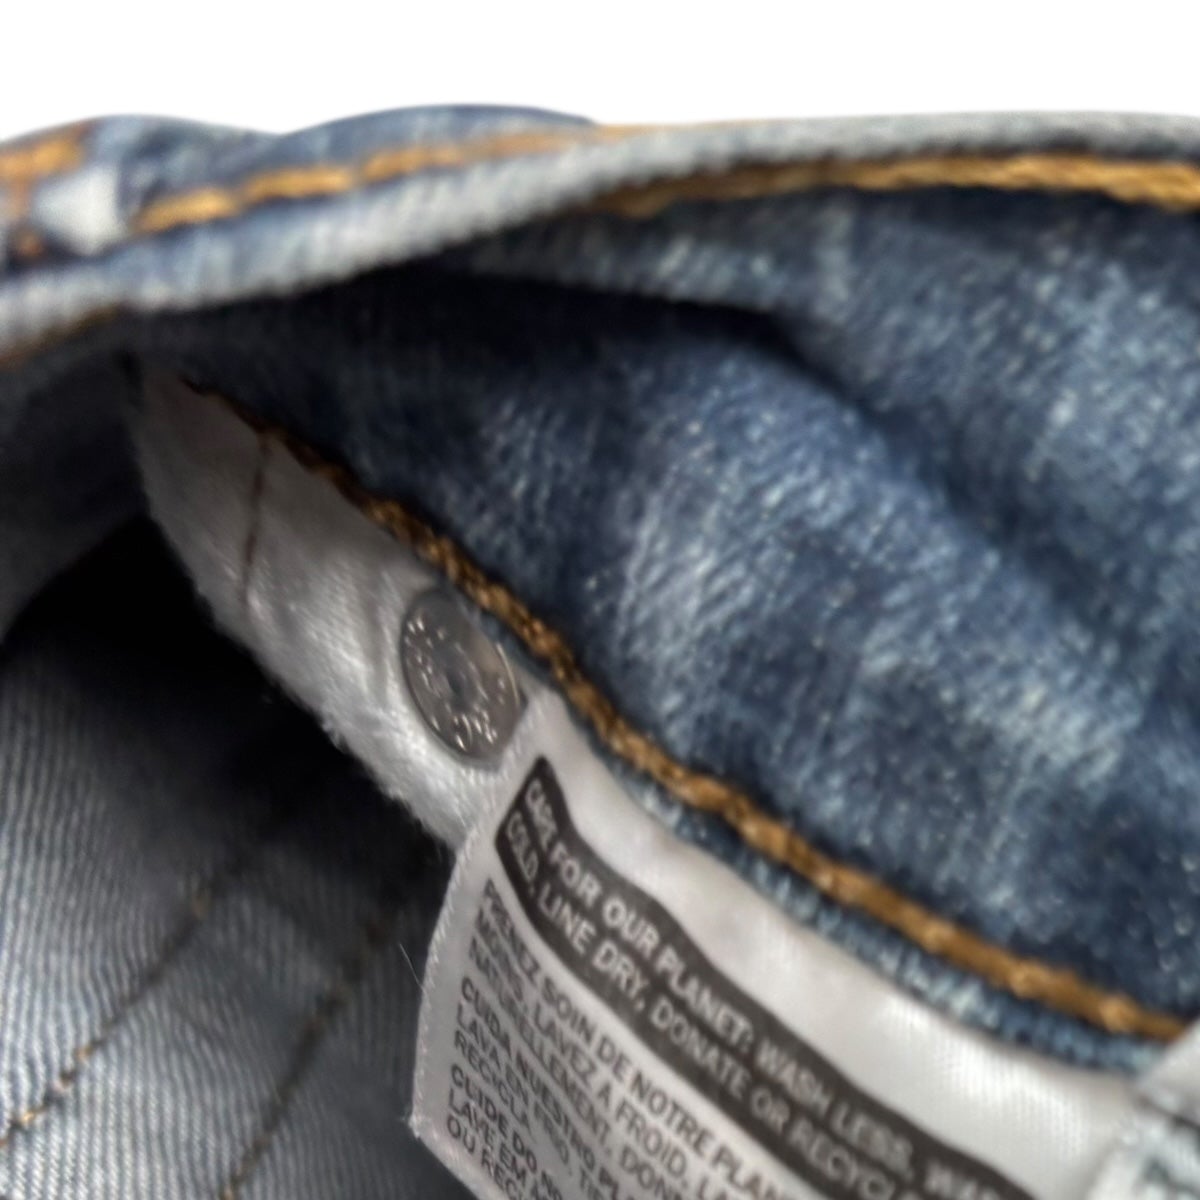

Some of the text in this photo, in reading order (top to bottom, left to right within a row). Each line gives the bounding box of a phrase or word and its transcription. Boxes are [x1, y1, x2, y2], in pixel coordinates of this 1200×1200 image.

[536, 882, 598, 955] LINE
[592, 940, 649, 1012] DRY,
[650, 995, 753, 1100] DONATE
[750, 1086, 791, 1135] OR
[549, 840, 603, 909] FOR
[602, 896, 661, 960] OUR
[653, 945, 756, 1053] PLANET:
[757, 1038, 834, 1118] WASH
[446, 1113, 477, 1155] OU
[448, 1088, 497, 1151] LAVE
[498, 1141, 528, 1188] EM
[451, 1063, 508, 1139] CUIDE
[511, 1130, 538, 1175] DO
[541, 976, 598, 1044] SOIN
[598, 1032, 633, 1083] DE
[630, 1070, 715, 1157] NOTRE
